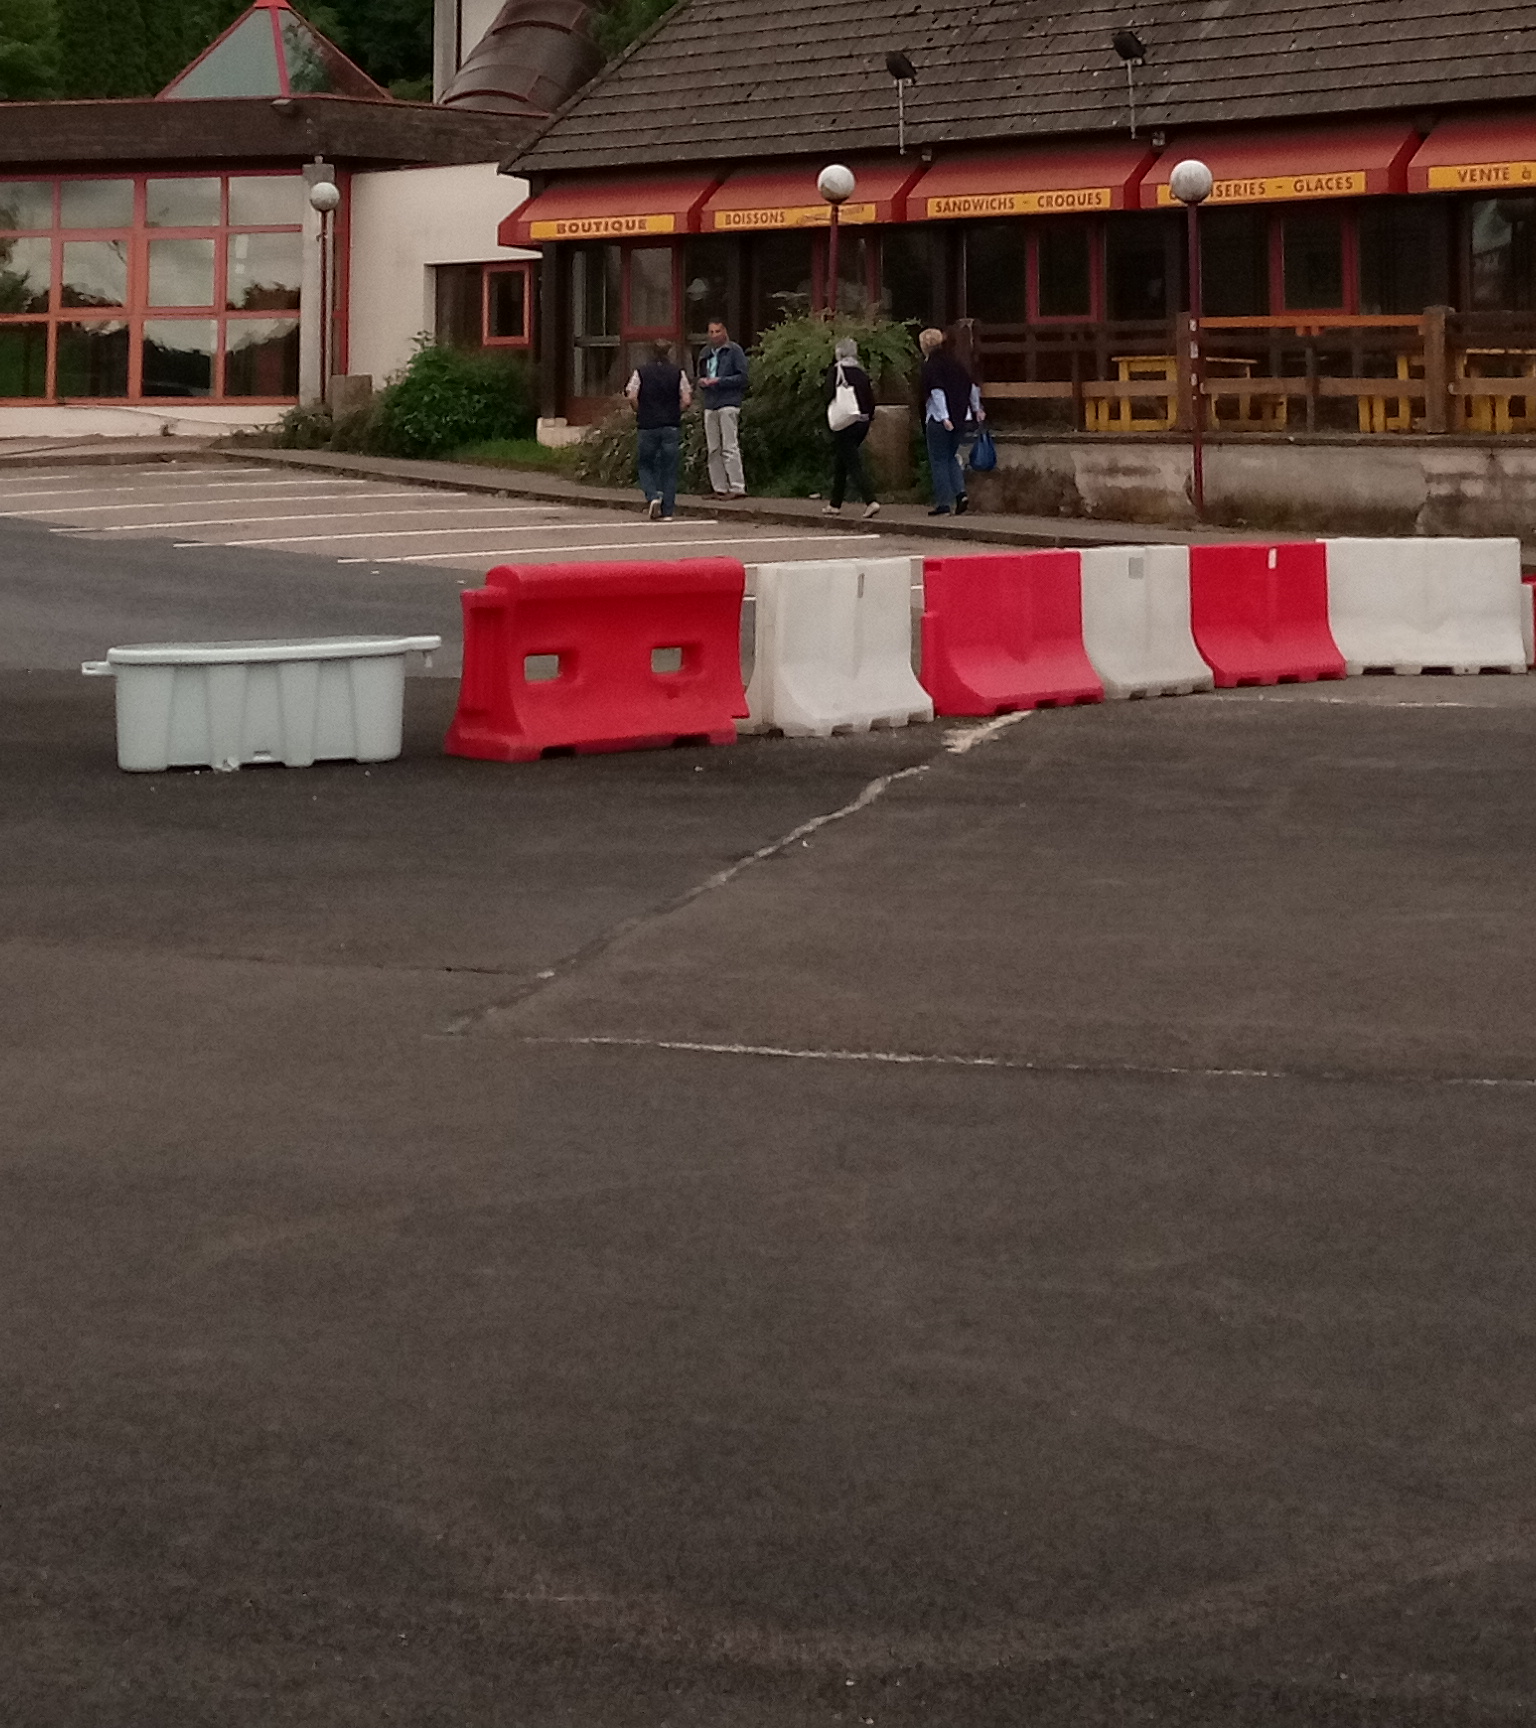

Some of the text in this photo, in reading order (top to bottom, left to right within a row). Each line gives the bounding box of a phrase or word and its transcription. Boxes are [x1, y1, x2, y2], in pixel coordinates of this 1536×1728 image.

[1457, 166, 1510, 183] VENTE
[1293, 176, 1353, 193] GLACES
[1037, 192, 1102, 208] CROQUES
[556, 218, 648, 235] BOUTIQUE
[725, 211, 786, 226] BOISSONS
